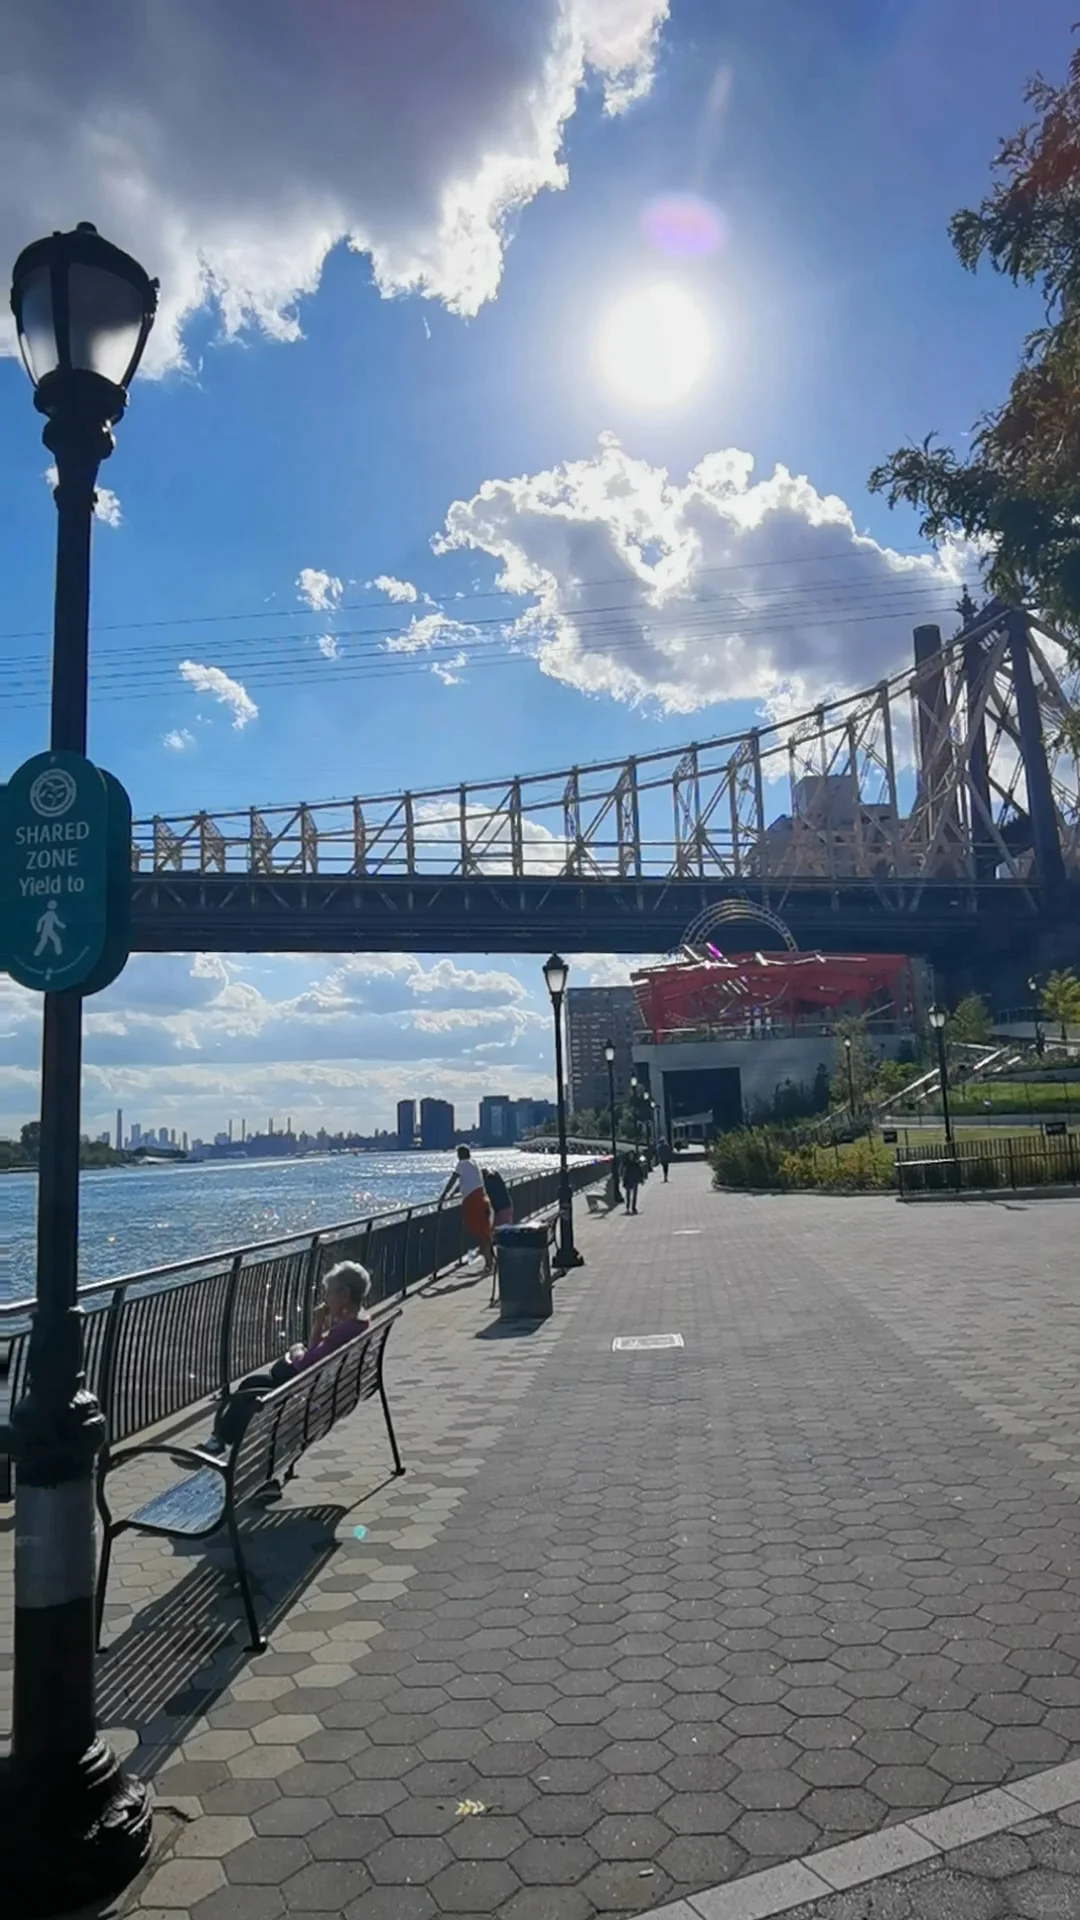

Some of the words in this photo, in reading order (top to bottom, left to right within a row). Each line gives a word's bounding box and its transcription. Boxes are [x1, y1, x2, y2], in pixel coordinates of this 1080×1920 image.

[15, 821, 90, 845] SHARED
[26, 847, 78, 870] ZONE
[18, 874, 61, 897] Yield
[67, 875, 85, 893] to
